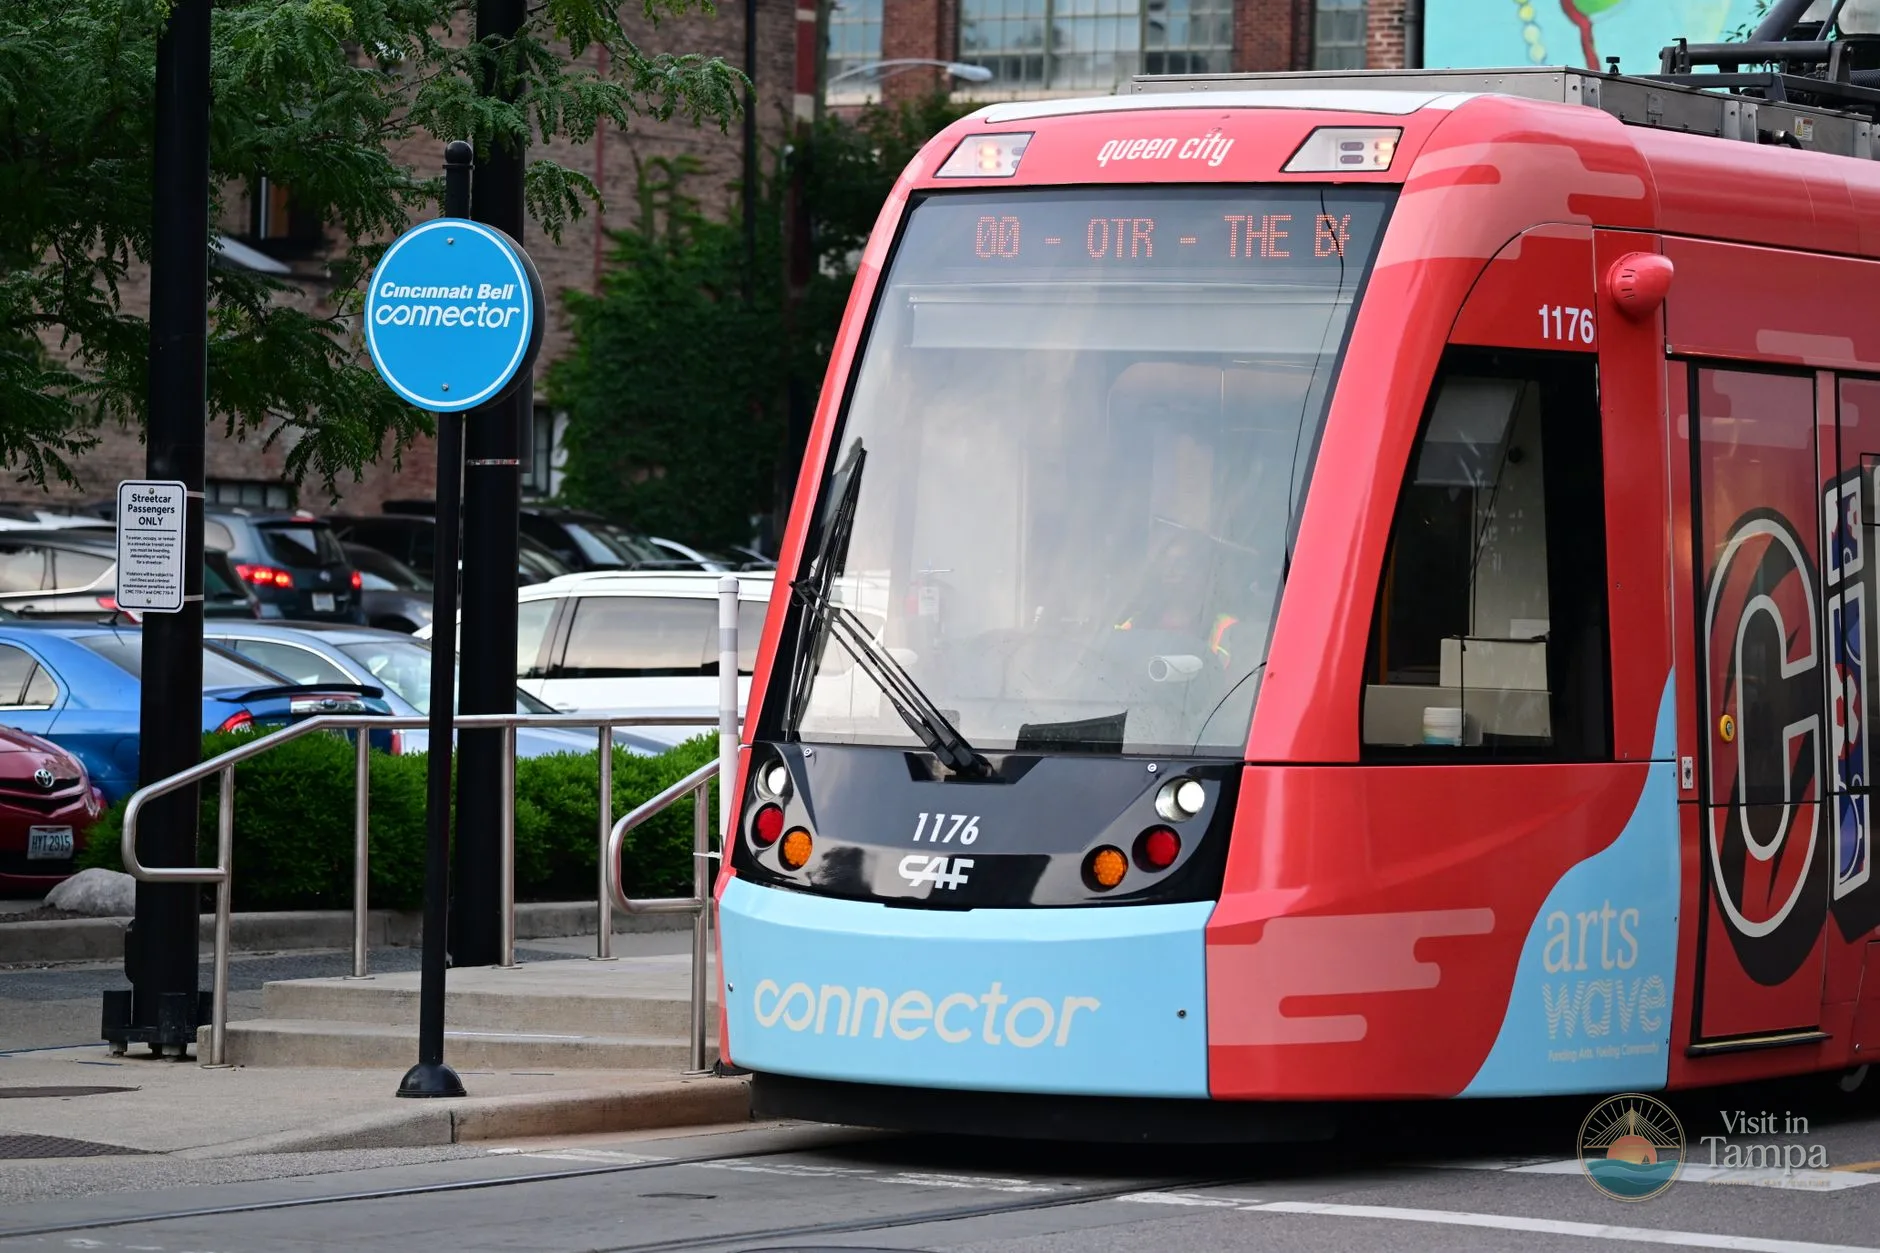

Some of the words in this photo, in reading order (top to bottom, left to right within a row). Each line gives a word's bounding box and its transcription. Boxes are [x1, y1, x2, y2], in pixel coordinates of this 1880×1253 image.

[1097, 137, 1177, 167] queen
[1178, 131, 1235, 167] city
[1087, 218, 1155, 258] OTR
[1224, 214, 1292, 257] THE
[380, 282, 473, 299] Cincinnati
[477, 283, 514, 300] Bell
[375, 302, 520, 328] connector
[1538, 304, 1595, 344] 1176
[128, 504, 175, 516] Passengers
[131, 494, 172, 503] Streetcar
[138, 516, 164, 526] ONLY
[912, 812, 981, 845] 1176
[898, 855, 975, 891] CAF
[1543, 899, 1639, 974] arts
[754, 978, 1101, 1048] connector
[1542, 974, 1666, 1040] wave
